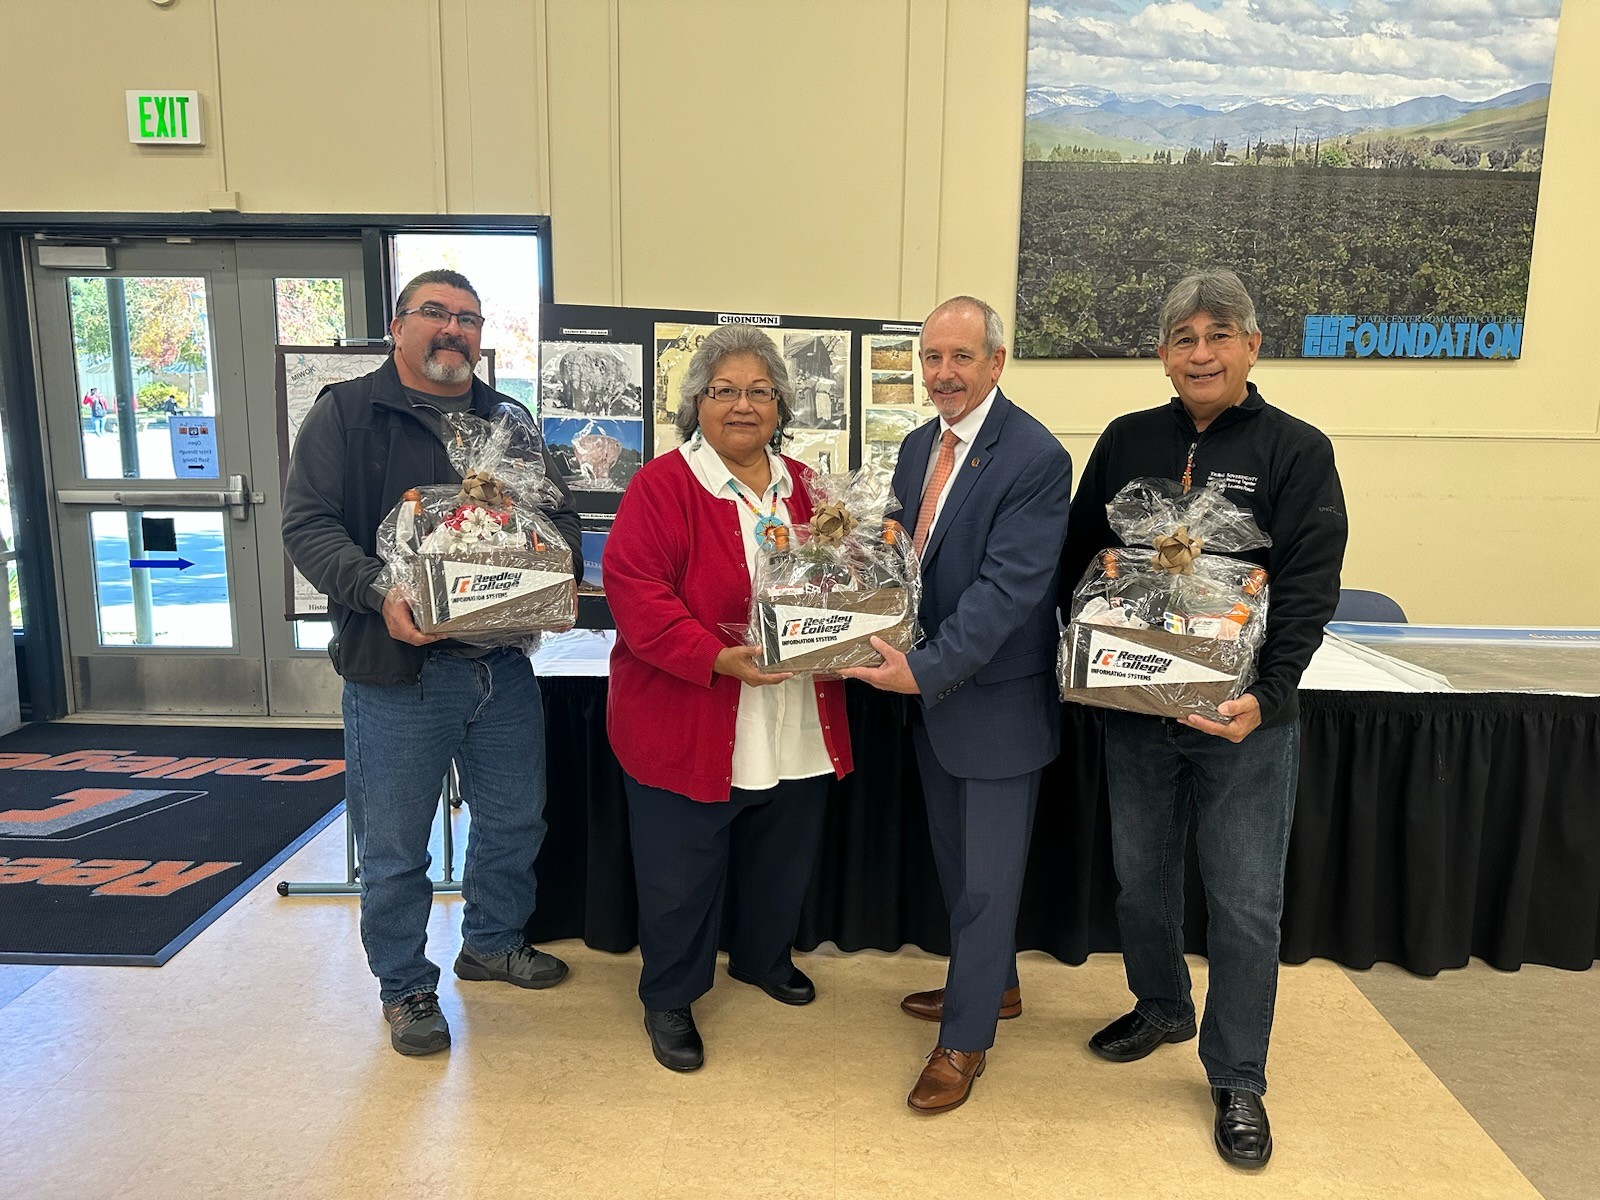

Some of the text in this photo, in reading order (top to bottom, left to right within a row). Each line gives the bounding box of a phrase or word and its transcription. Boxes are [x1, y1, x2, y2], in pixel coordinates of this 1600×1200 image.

[138, 96, 189, 138] EXIT
[720, 315, 779, 324] CHOINUMNI
[1357, 315, 1524, 324] STATE CENTER COMMUNITY COLLEGE
[1337, 317, 1523, 358] FOUNDATION
[290, 363, 317, 382] MIWOK
[473, 571, 523, 583] Reedley
[470, 580, 521, 592] College
[803, 615, 853, 627] Reedley
[801, 623, 850, 635] College
[781, 635, 838, 646] INFORMATION SYSTEMS
[1117, 650, 1173, 667] Reedley
[1090, 668, 1152, 681] INFORMATION SYSTEMS
[0, 856, 243, 897] Ree
